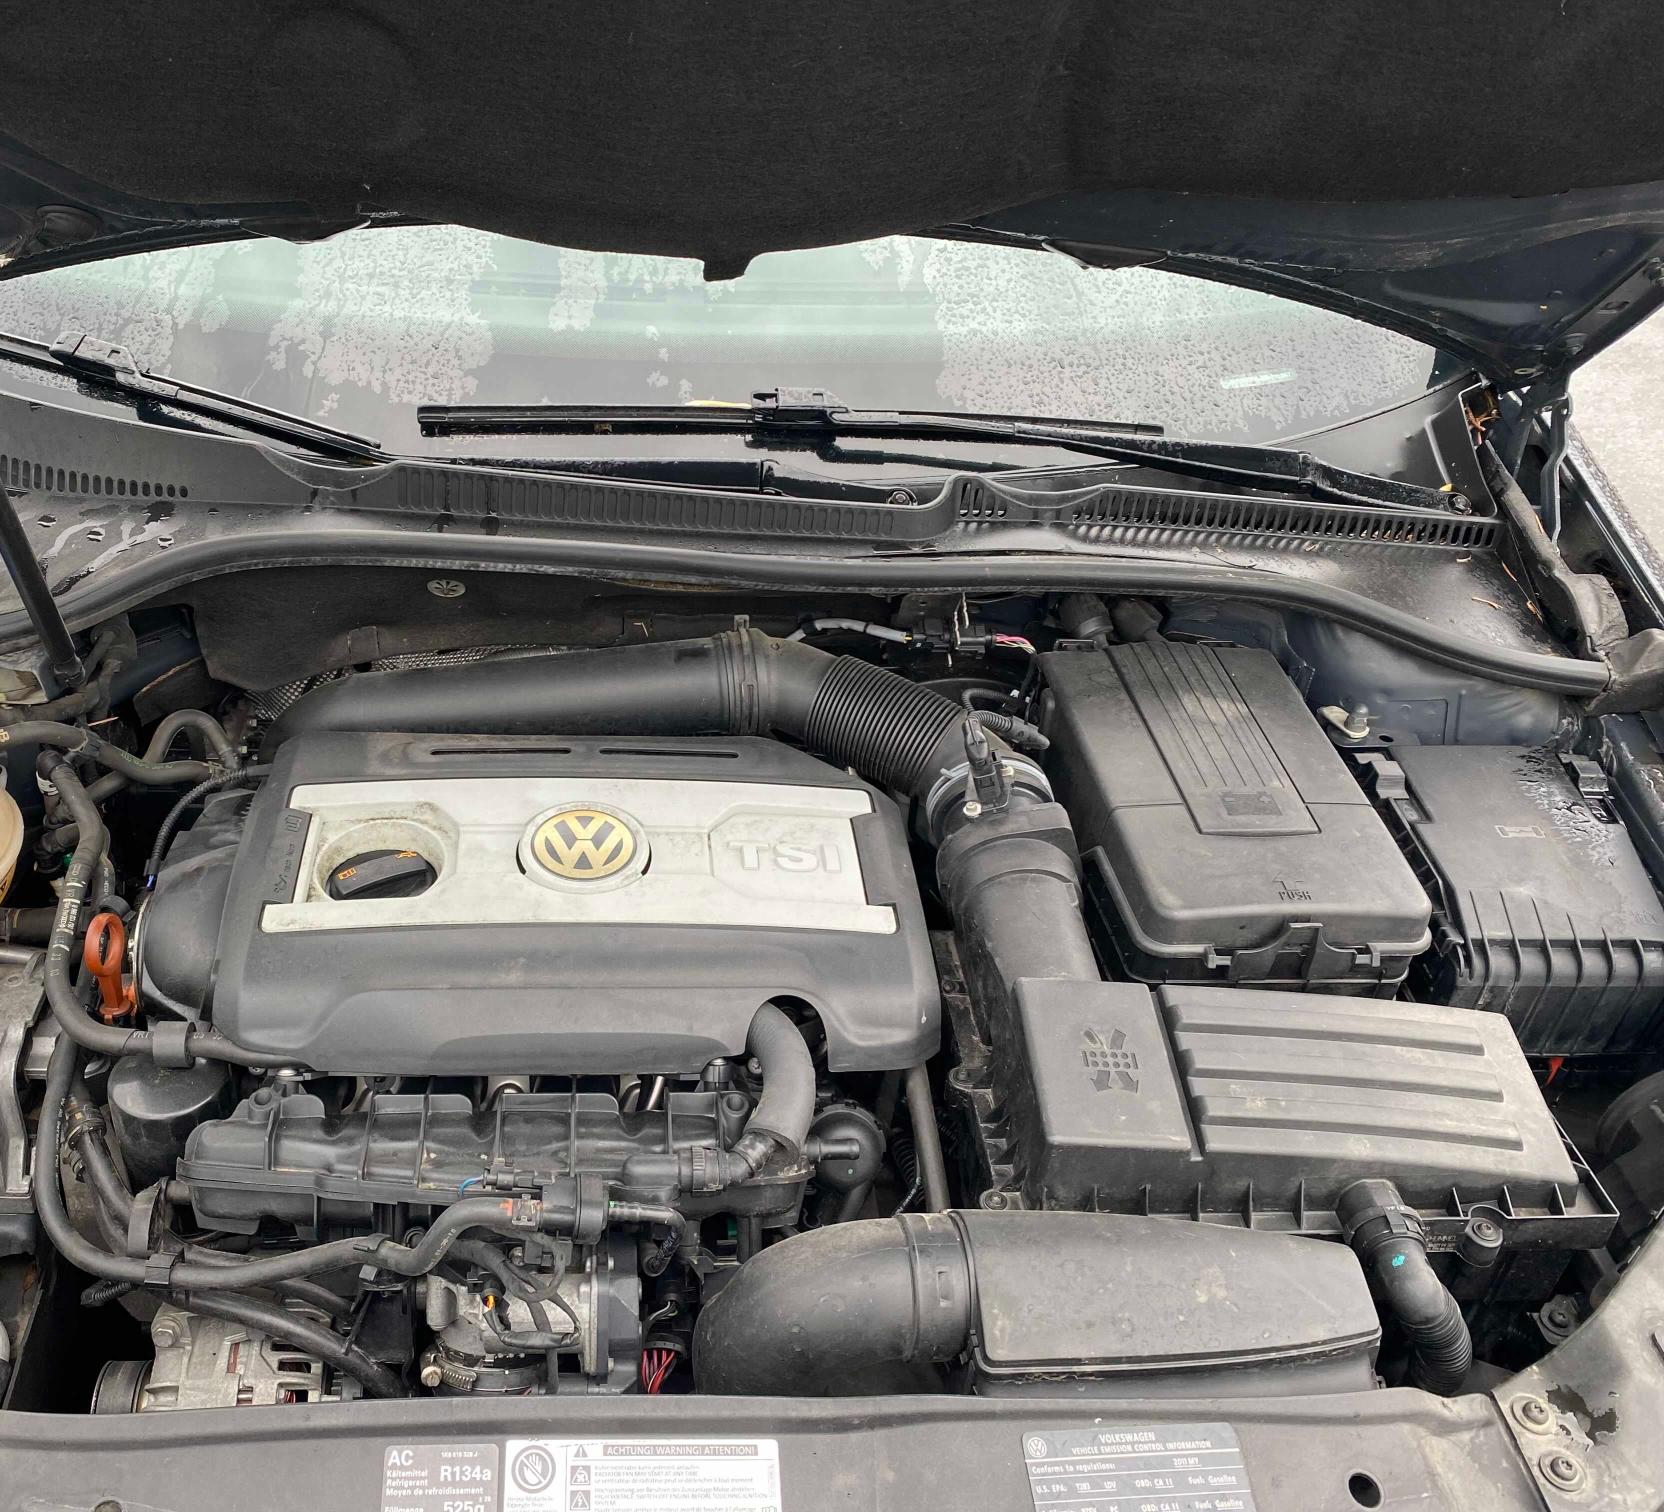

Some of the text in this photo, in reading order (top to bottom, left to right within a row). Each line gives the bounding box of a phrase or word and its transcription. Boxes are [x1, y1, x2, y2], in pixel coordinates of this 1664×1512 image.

[728, 839, 842, 873] TSI
[1278, 890, 1313, 901] PUSH
[1099, 1431, 1156, 1444] VOLKSWAGEN
[607, 1446, 654, 1455] ACHTUNG!
[704, 1446, 755, 1455] ATTENTION!
[1072, 1440, 1212, 1455] VEHICLE EMISSION CONTROL INFORMATION
[387, 1449, 414, 1467] AC
[386, 1470, 428, 1478] Kältemittel
[440, 1465, 492, 1482] R134a
[1032, 1464, 1064, 1474] Conforms
[1065, 1464, 1074, 1472] to
[386, 1479, 429, 1488] Refrigerant
[386, 1487, 484, 1497] Moyen de refroidissement
